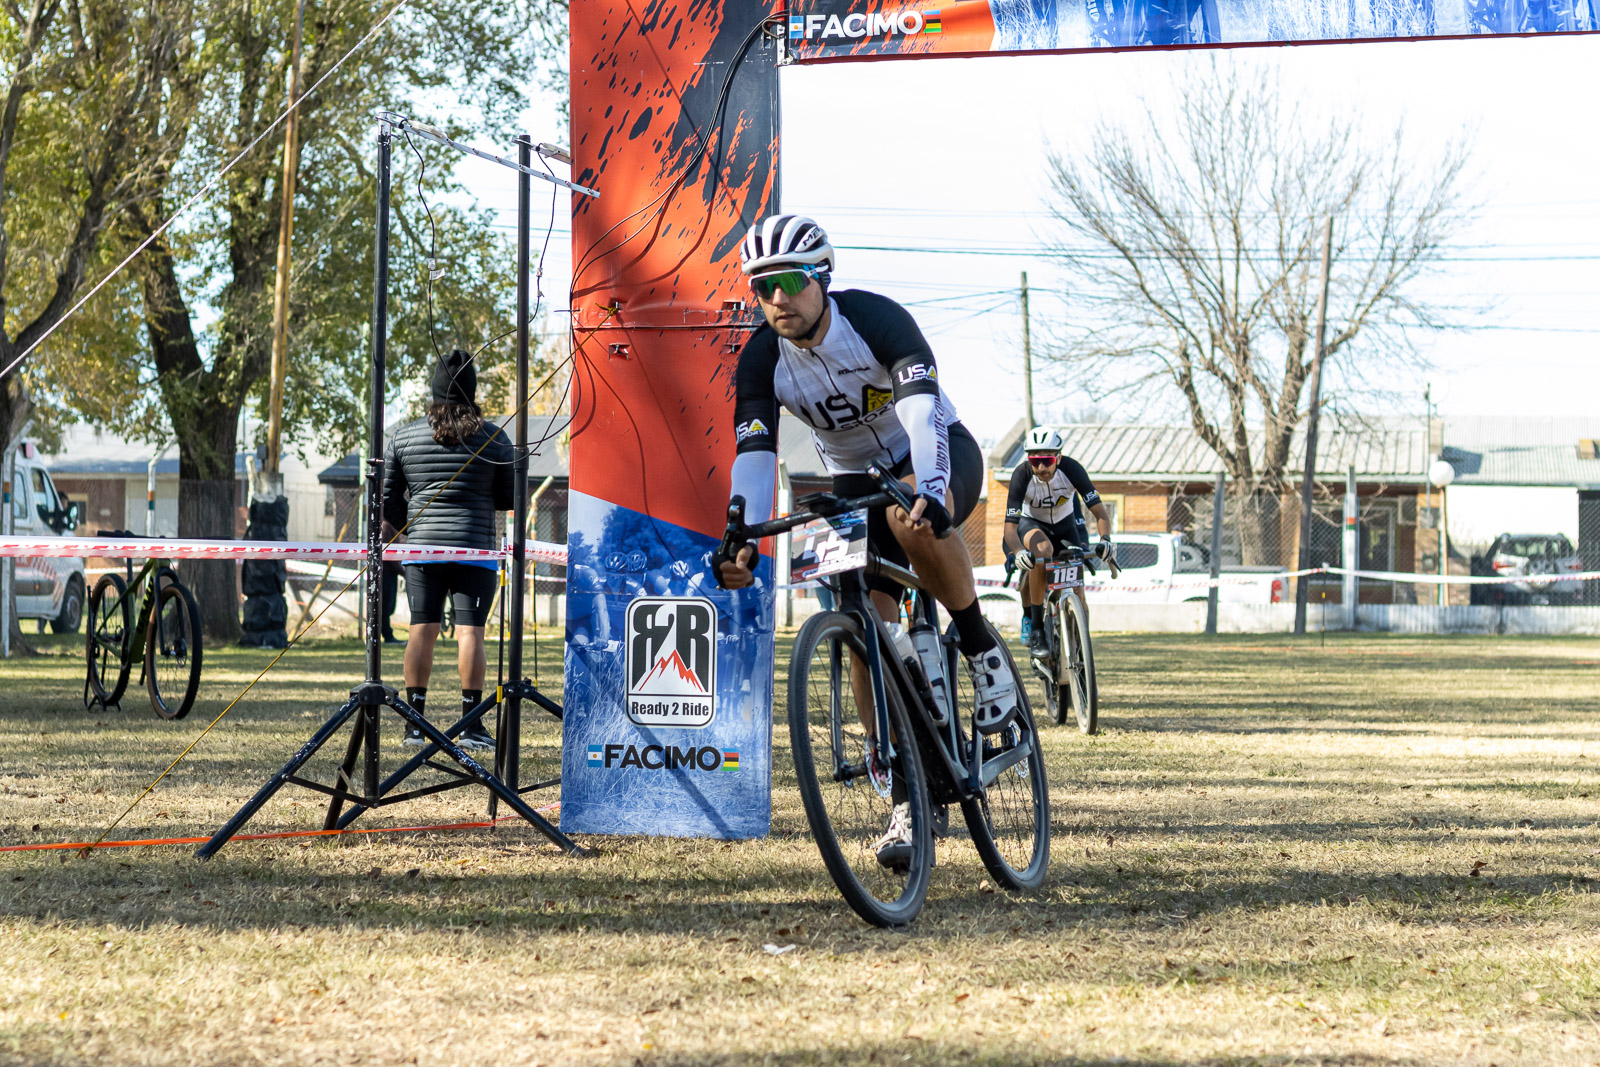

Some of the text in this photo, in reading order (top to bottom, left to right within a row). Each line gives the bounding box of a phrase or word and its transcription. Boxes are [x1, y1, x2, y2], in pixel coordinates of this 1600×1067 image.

[805, 10, 923, 39] FACIMO
[898, 363, 937, 382] USA
[800, 384, 892, 430] USA
[1030, 496, 1069, 509] USA
[1083, 489, 1099, 502] USA
[1006, 508, 1021, 517] USA
[1053, 567, 1079, 584] 118
[631, 701, 710, 717] Ready 2 Ride
[604, 744, 722, 772] FACIMO
